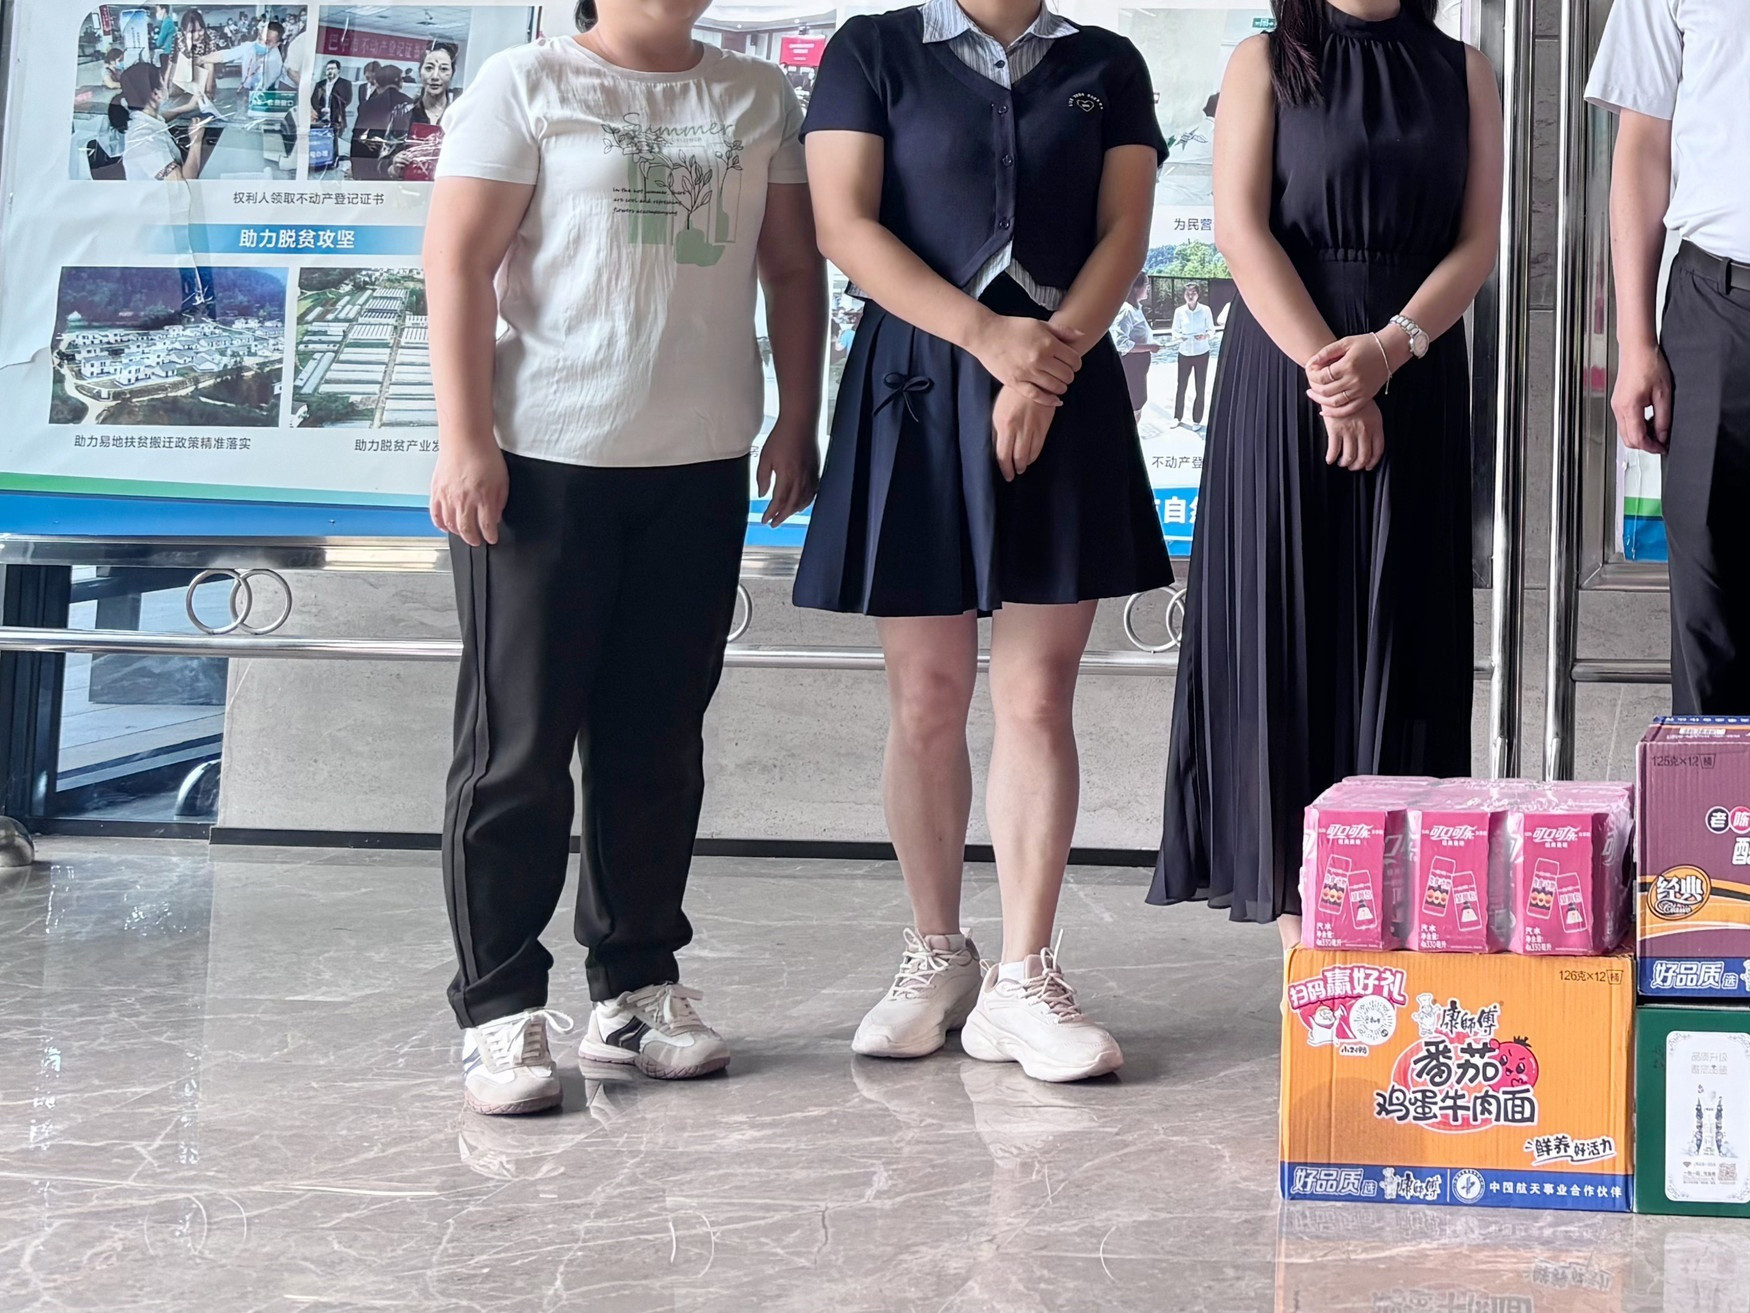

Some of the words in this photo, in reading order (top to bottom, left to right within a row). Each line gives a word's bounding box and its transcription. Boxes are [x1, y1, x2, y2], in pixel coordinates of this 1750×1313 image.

[622, 112, 733, 136] Summer
[233, 192, 385, 205] 权利人领取不动产登记证书
[1174, 217, 1212, 231] 为民营
[239, 229, 355, 249] 助力脱贫攻坚
[74, 434, 252, 450] 助力易地扶贫搬迁政策精准落实
[1326, 823, 1374, 840] 可口可乐
[1429, 824, 1478, 841] 可口可乐
[1532, 825, 1582, 843] 可口可乐
[1656, 875, 1704, 903] 经典
[1651, 960, 1725, 988] 好品质
[1289, 967, 1405, 1007] 扫码赢好礼
[1412, 1039, 1501, 1087] 番茄
[1375, 1088, 1536, 1123] 鸡蛋牛肉面
[1534, 1135, 1570, 1158] 鲜养
[1573, 1137, 1614, 1157] 好活力
[1292, 1167, 1364, 1196] 好品质
[1488, 1181, 1624, 1199] 中国航天事业合作伙伴
